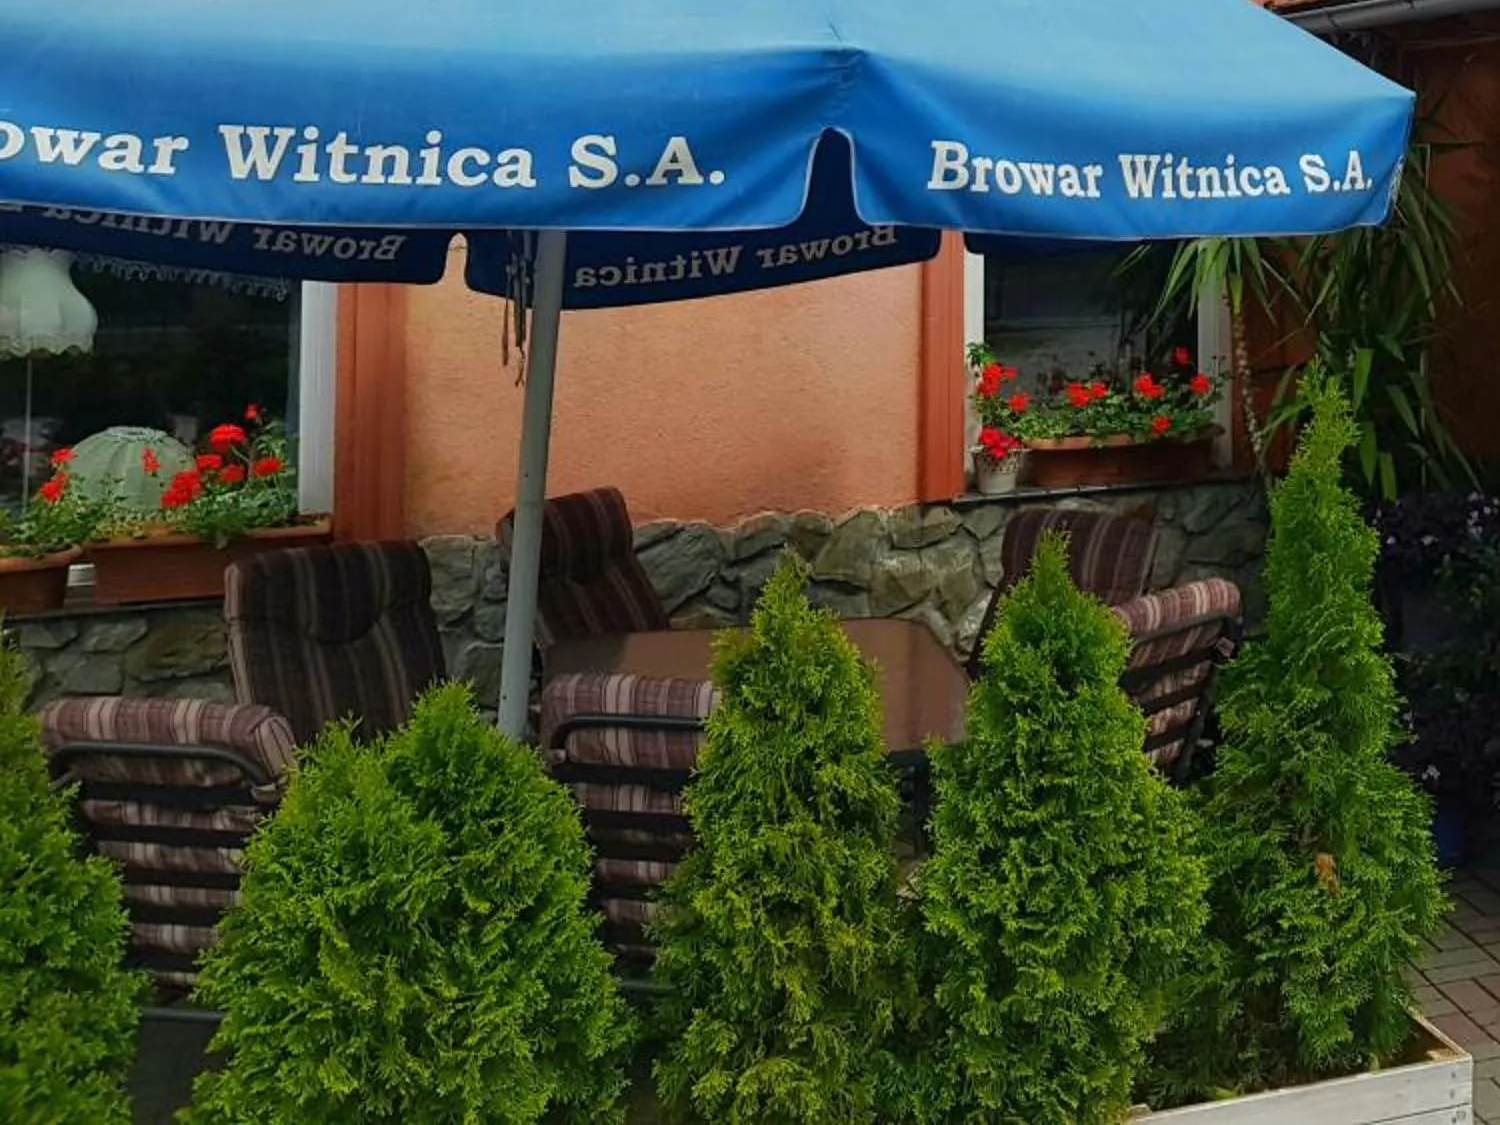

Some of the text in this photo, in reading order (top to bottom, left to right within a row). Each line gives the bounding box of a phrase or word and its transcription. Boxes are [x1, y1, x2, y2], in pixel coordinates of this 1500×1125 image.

[218, 124, 537, 188] Witnica
[568, 136, 726, 187] S.A.
[927, 140, 1373, 199] Browar Witnica S.A.
